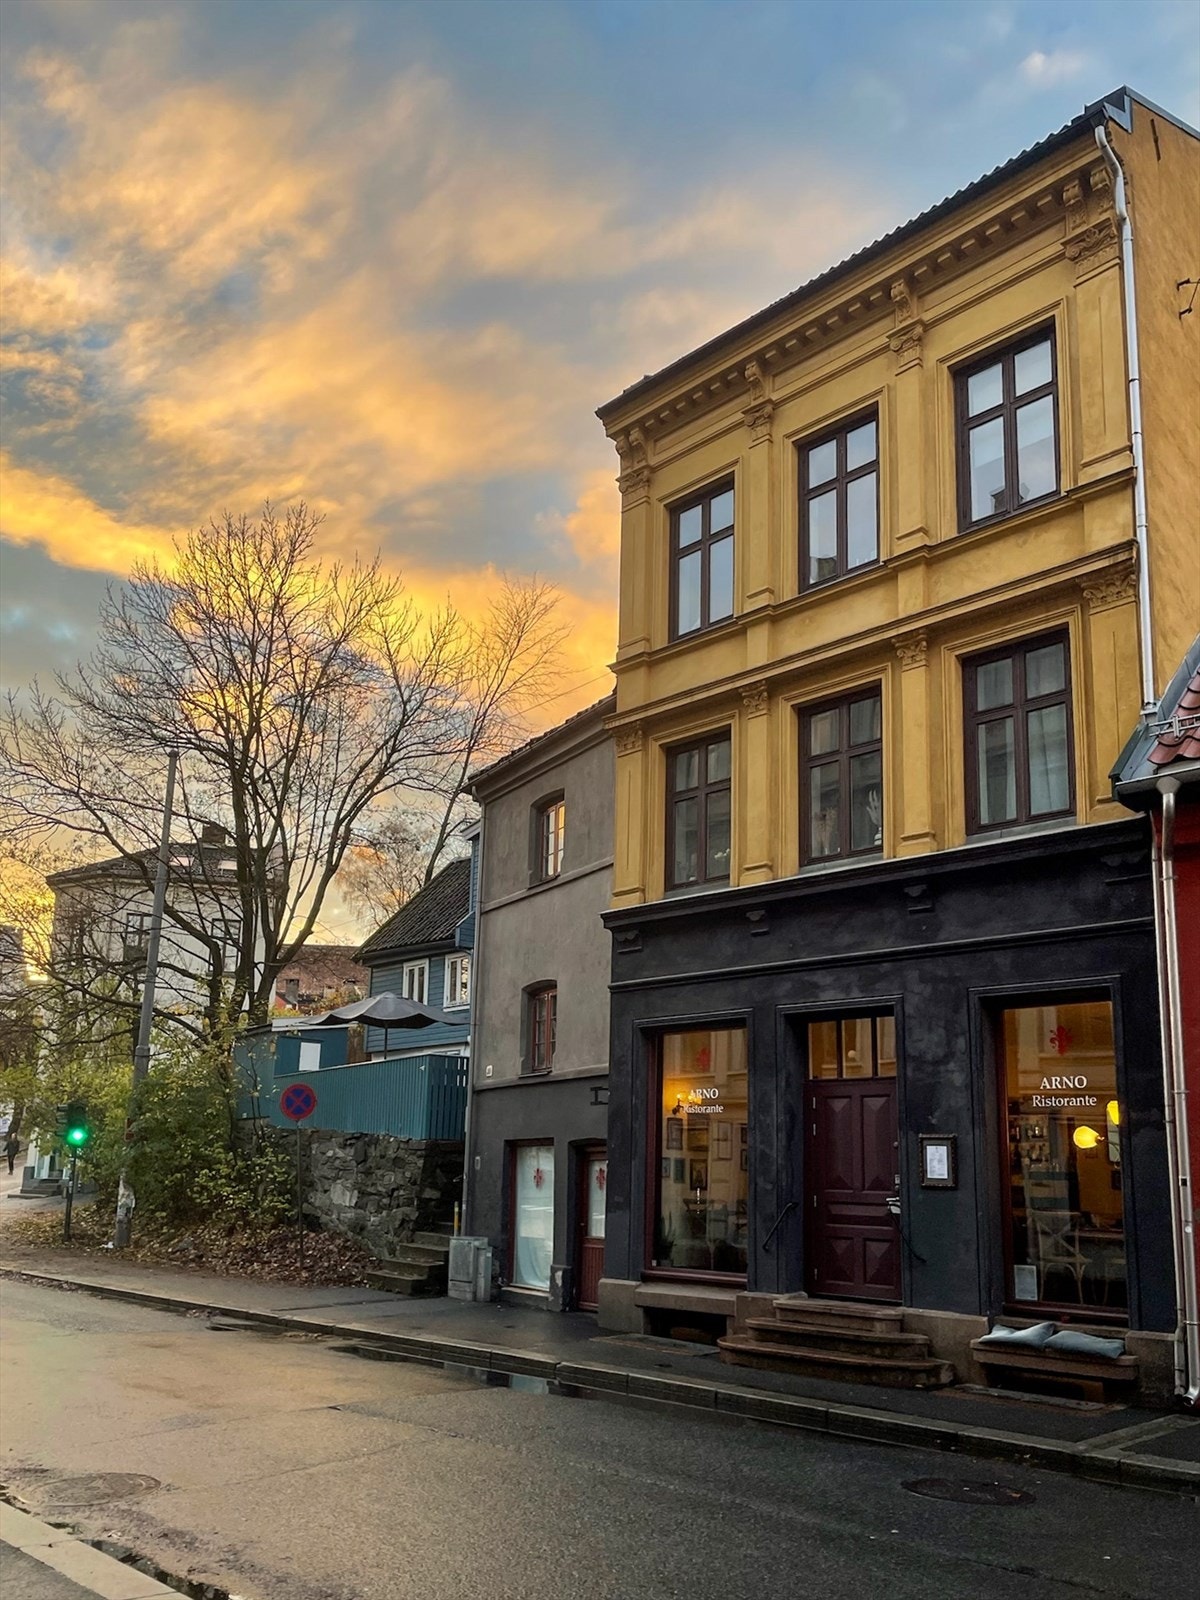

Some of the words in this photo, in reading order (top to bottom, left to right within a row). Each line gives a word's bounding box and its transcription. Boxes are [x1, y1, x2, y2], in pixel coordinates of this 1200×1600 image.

[1040, 1076, 1087, 1089] ARNO
[690, 1088, 719, 1099] ARNO
[1032, 1095, 1097, 1107] Ristorante
[683, 1105, 724, 1113] Ristorante
